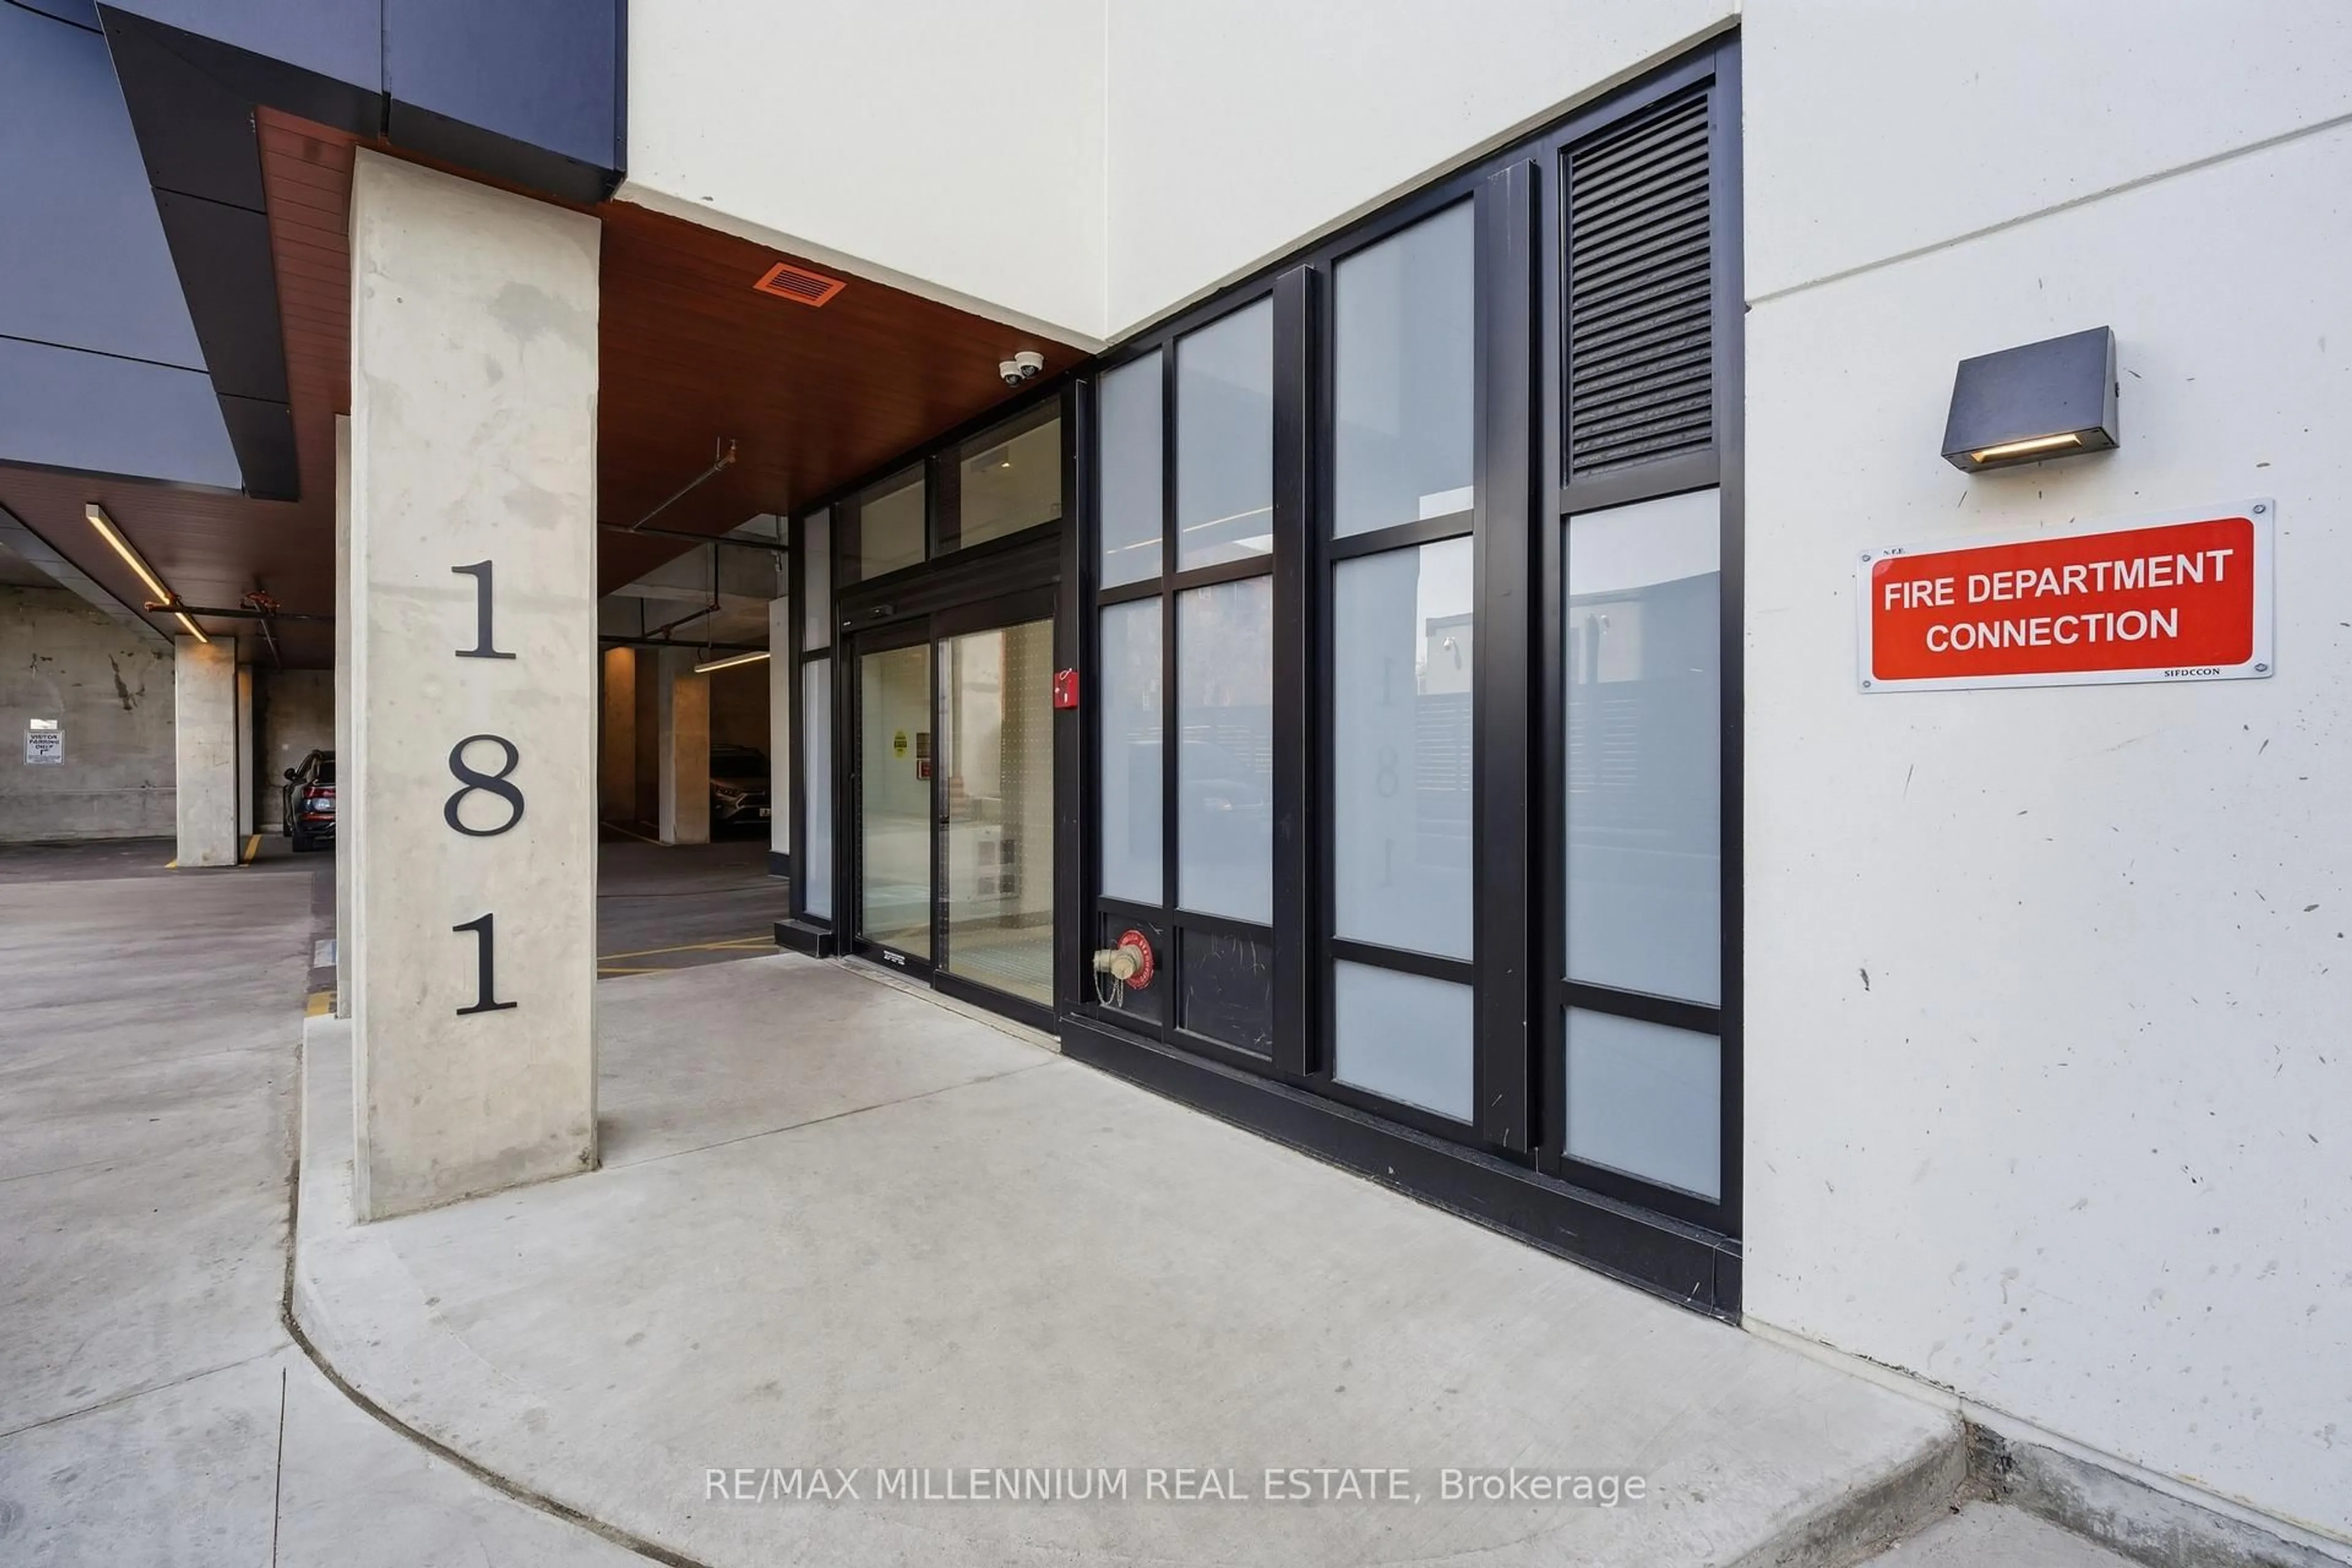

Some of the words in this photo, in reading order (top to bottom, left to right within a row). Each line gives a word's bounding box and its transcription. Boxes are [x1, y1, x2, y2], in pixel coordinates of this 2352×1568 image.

[1884, 582, 1955, 611] FIRE
[1967, 548, 2234, 603] DEPARTMENT
[1926, 607, 2178, 652] CONNECTION
[2163, 668, 2220, 677] SIFDCCON
